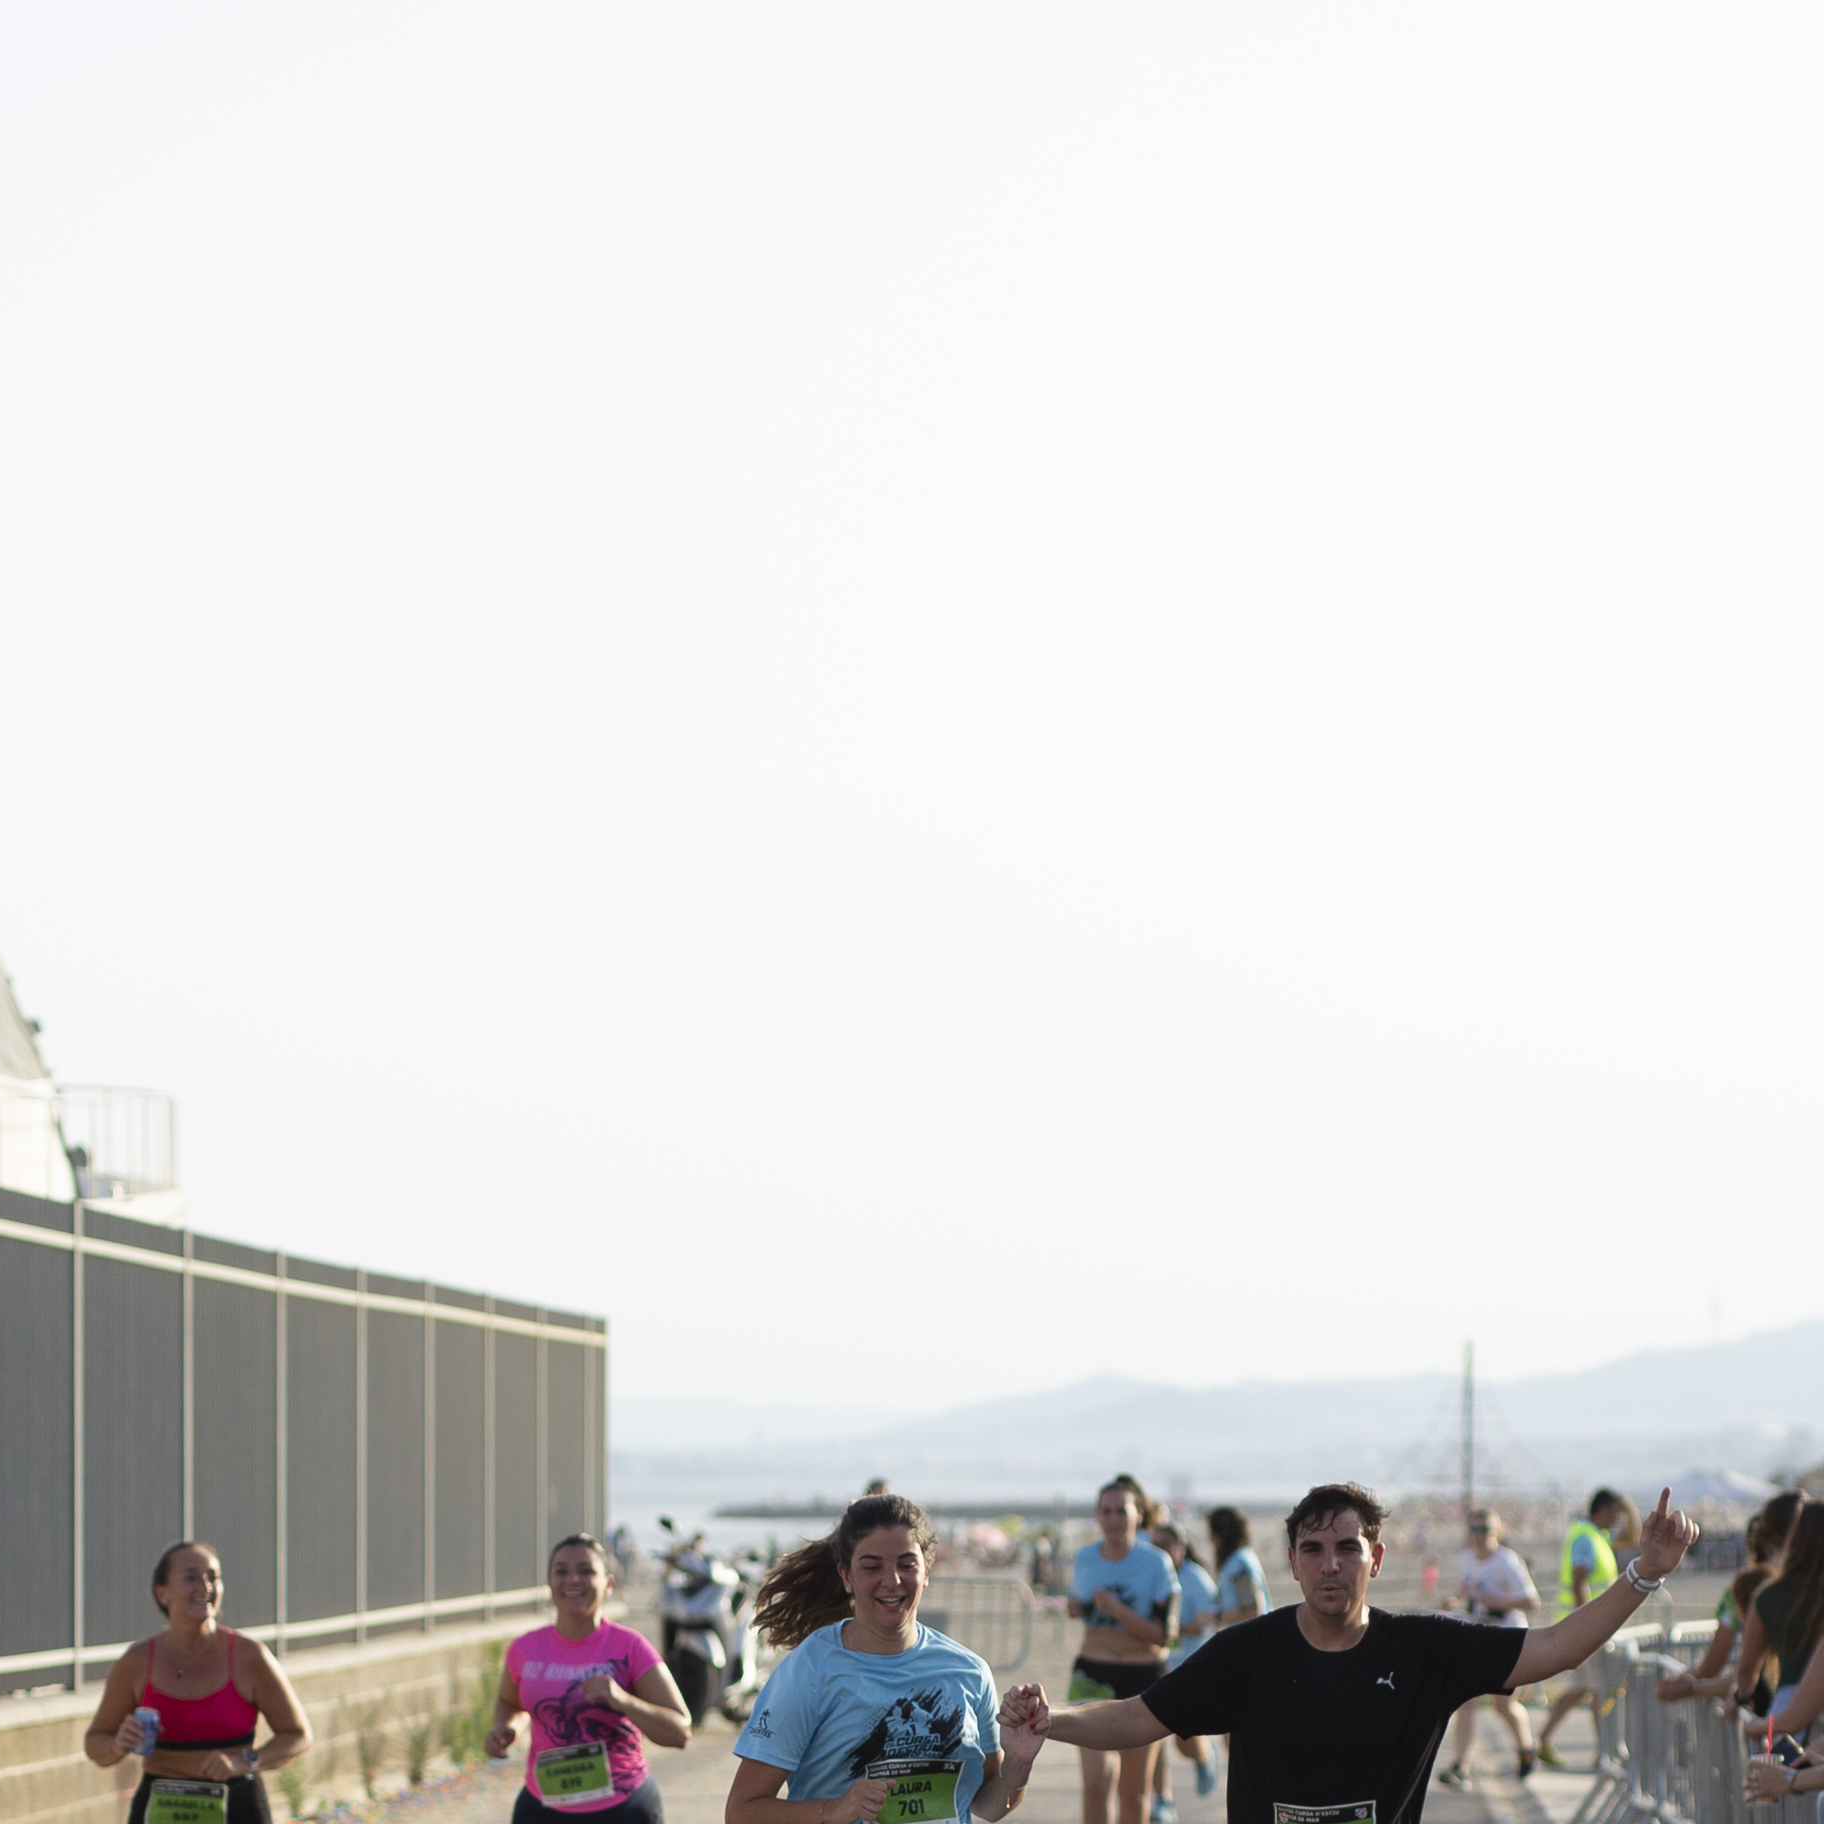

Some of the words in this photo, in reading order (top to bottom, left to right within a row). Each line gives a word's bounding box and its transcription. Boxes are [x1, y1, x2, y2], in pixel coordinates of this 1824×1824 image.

[896, 1733, 940, 1747] CURSA
[890, 1780, 933, 1797] LAURA
[898, 1798, 925, 1816] 701
